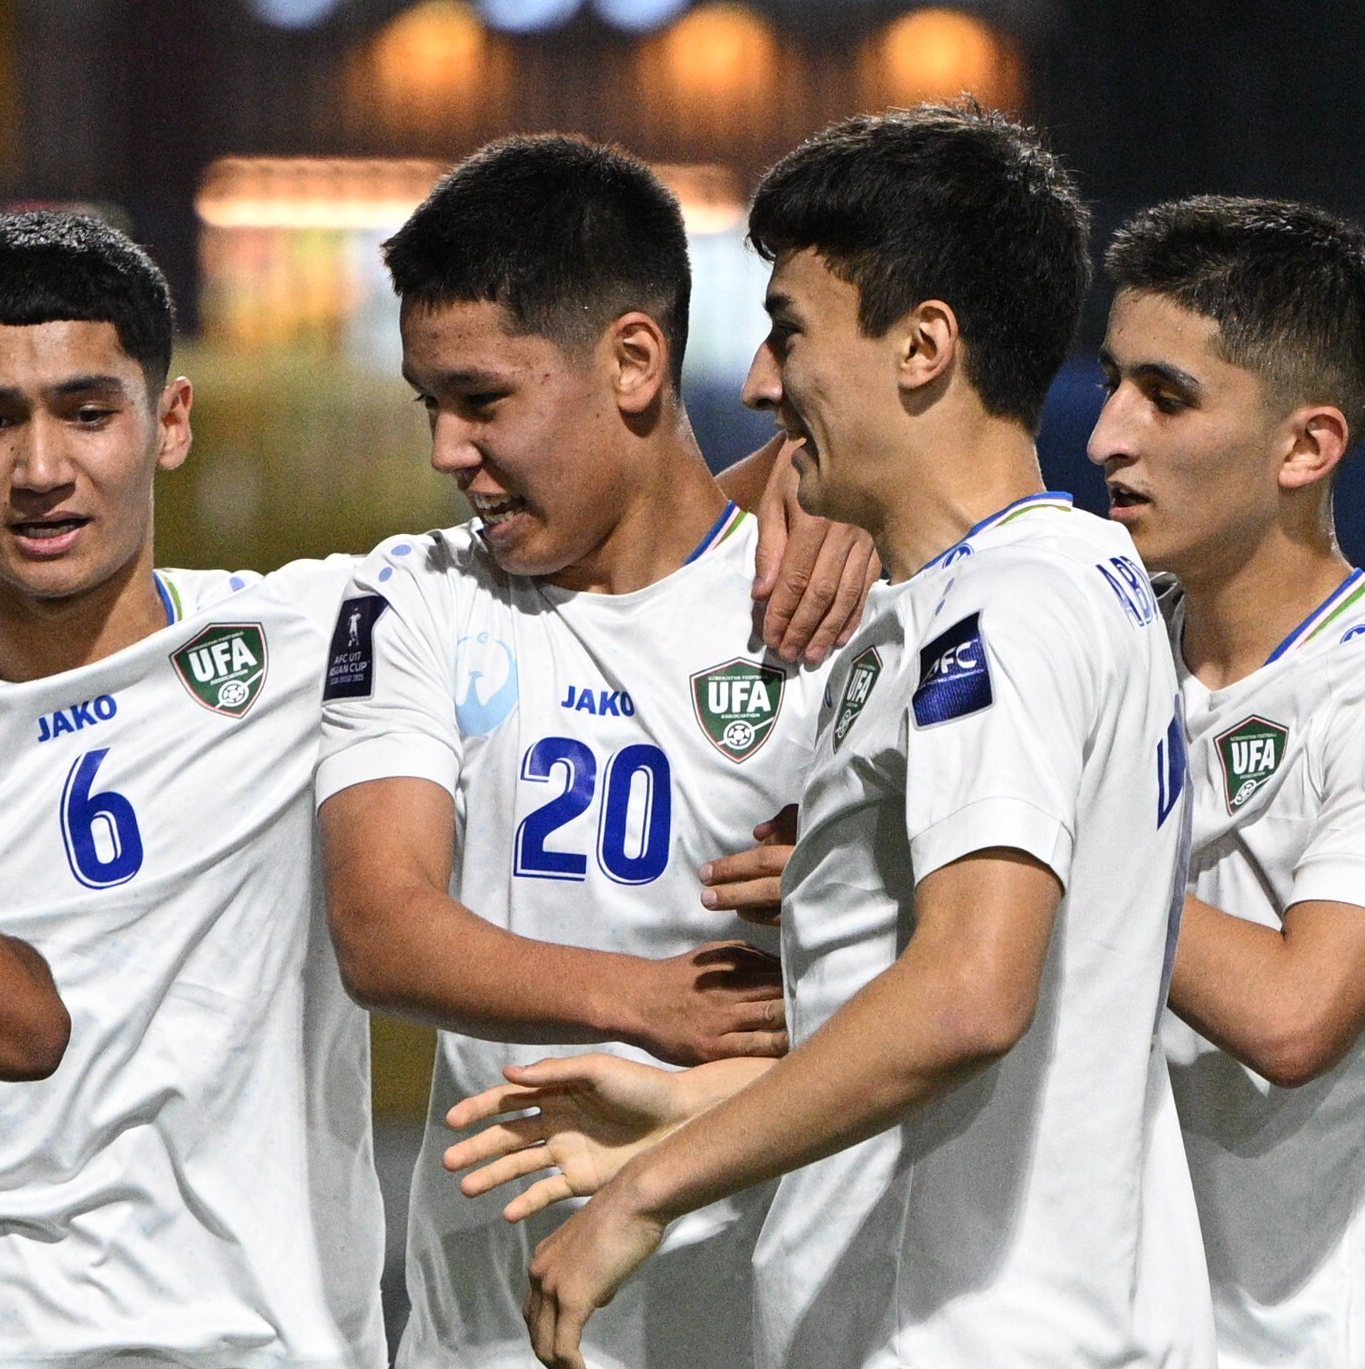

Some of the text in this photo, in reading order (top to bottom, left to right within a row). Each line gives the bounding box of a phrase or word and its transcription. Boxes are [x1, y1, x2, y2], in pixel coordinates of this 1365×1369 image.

[188, 637, 257, 682] UFA
[349, 662, 367, 672] CUP
[921, 640, 978, 686] AFC
[561, 685, 635, 717] JAKO
[708, 680, 771, 713] UFA
[846, 668, 874, 704] UFA
[37, 694, 117, 743] JAKO
[1231, 738, 1275, 775] UFA
[60, 747, 144, 890] 6
[513, 736, 672, 887] 20
